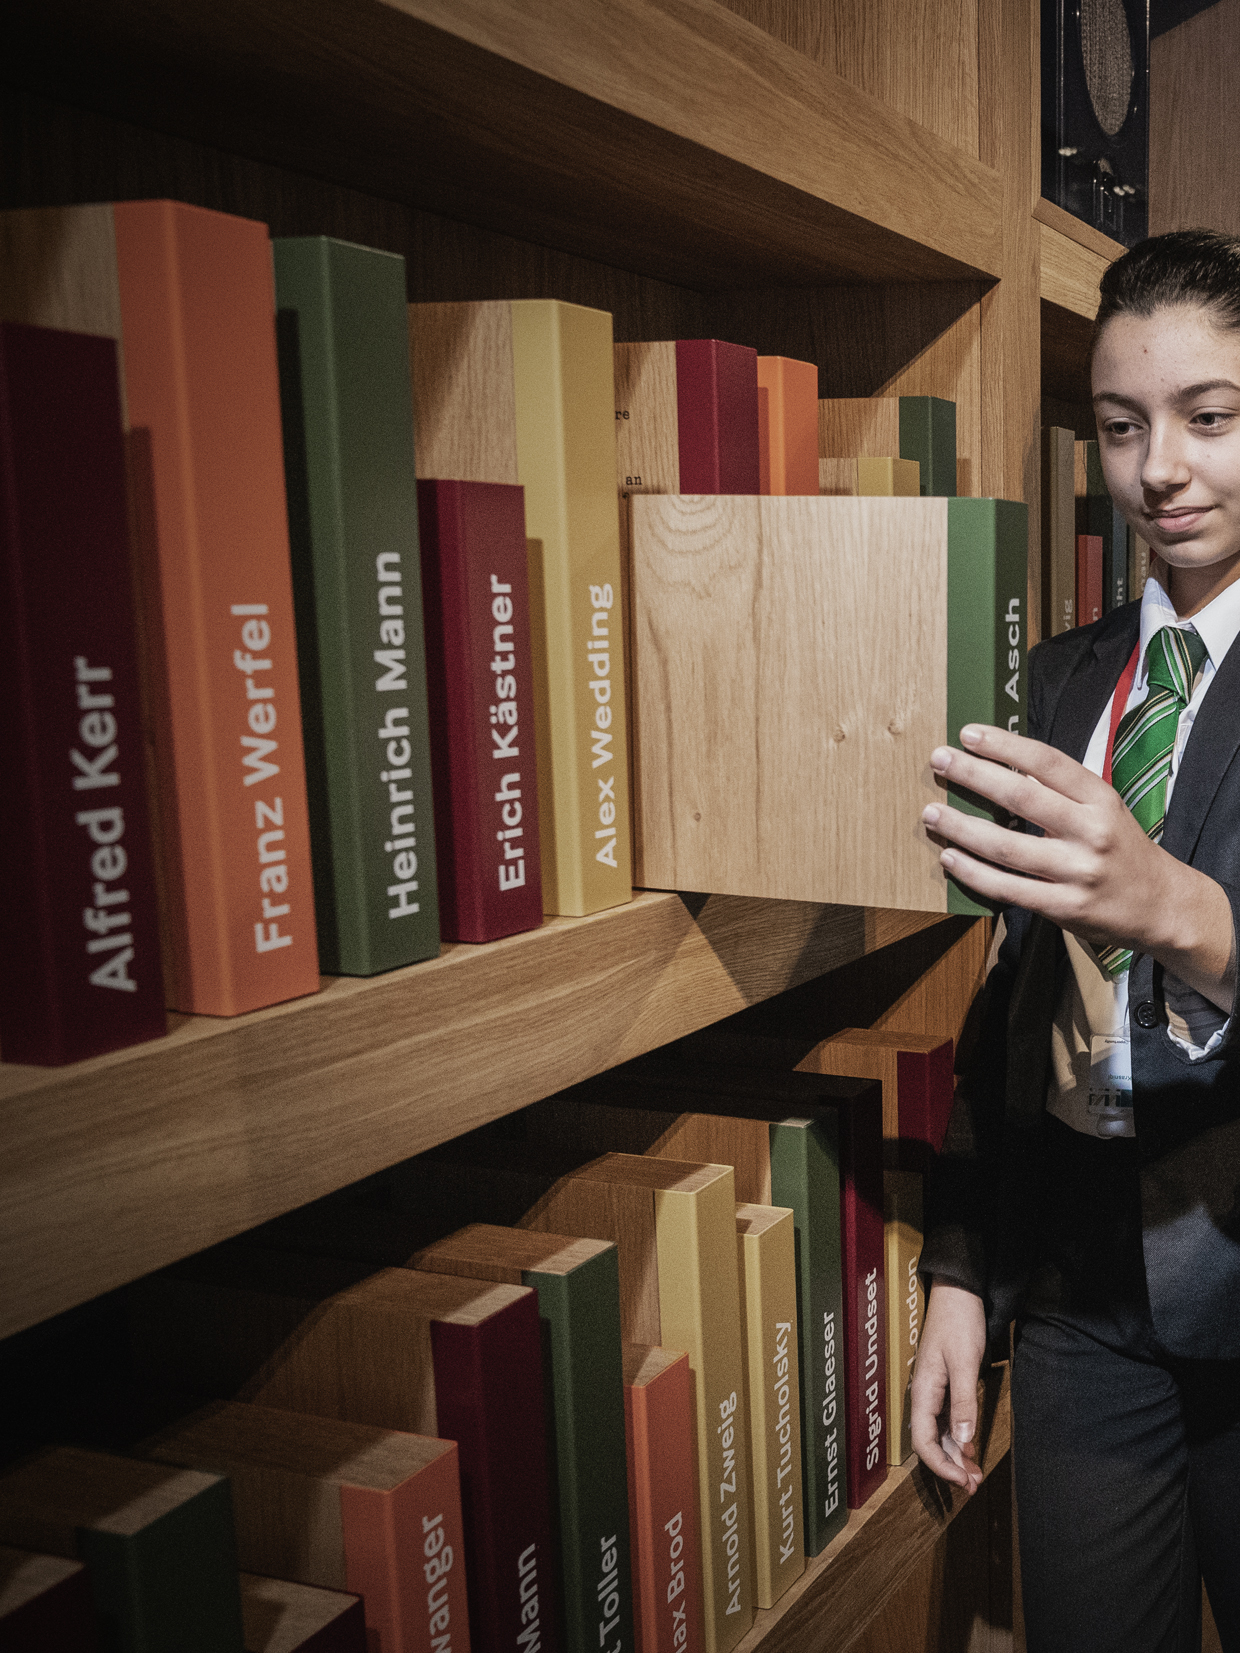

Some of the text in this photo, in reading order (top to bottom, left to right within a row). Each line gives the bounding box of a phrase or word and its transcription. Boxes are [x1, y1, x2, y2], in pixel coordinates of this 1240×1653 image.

[373, 551, 420, 919] Heinrich Mann
[489, 573, 526, 892] Erich Kästner
[586, 582, 618, 868] Alex Wedding
[1004, 597, 1020, 703] Asch
[71, 656, 137, 992] Alfred Kerr
[230, 603, 293, 953] Franz Werfel
[822, 1311, 839, 1518] Ernst Glaeser
[864, 1267, 882, 1471] Sigrid Undset
[905, 1256, 919, 1366] London
[717, 1391, 741, 1615] Arnold Zweig
[773, 1321, 794, 1564] Kurt Tucholsky
[598, 1534, 619, 1647] Toller
[664, 1511, 685, 1604] Brod
